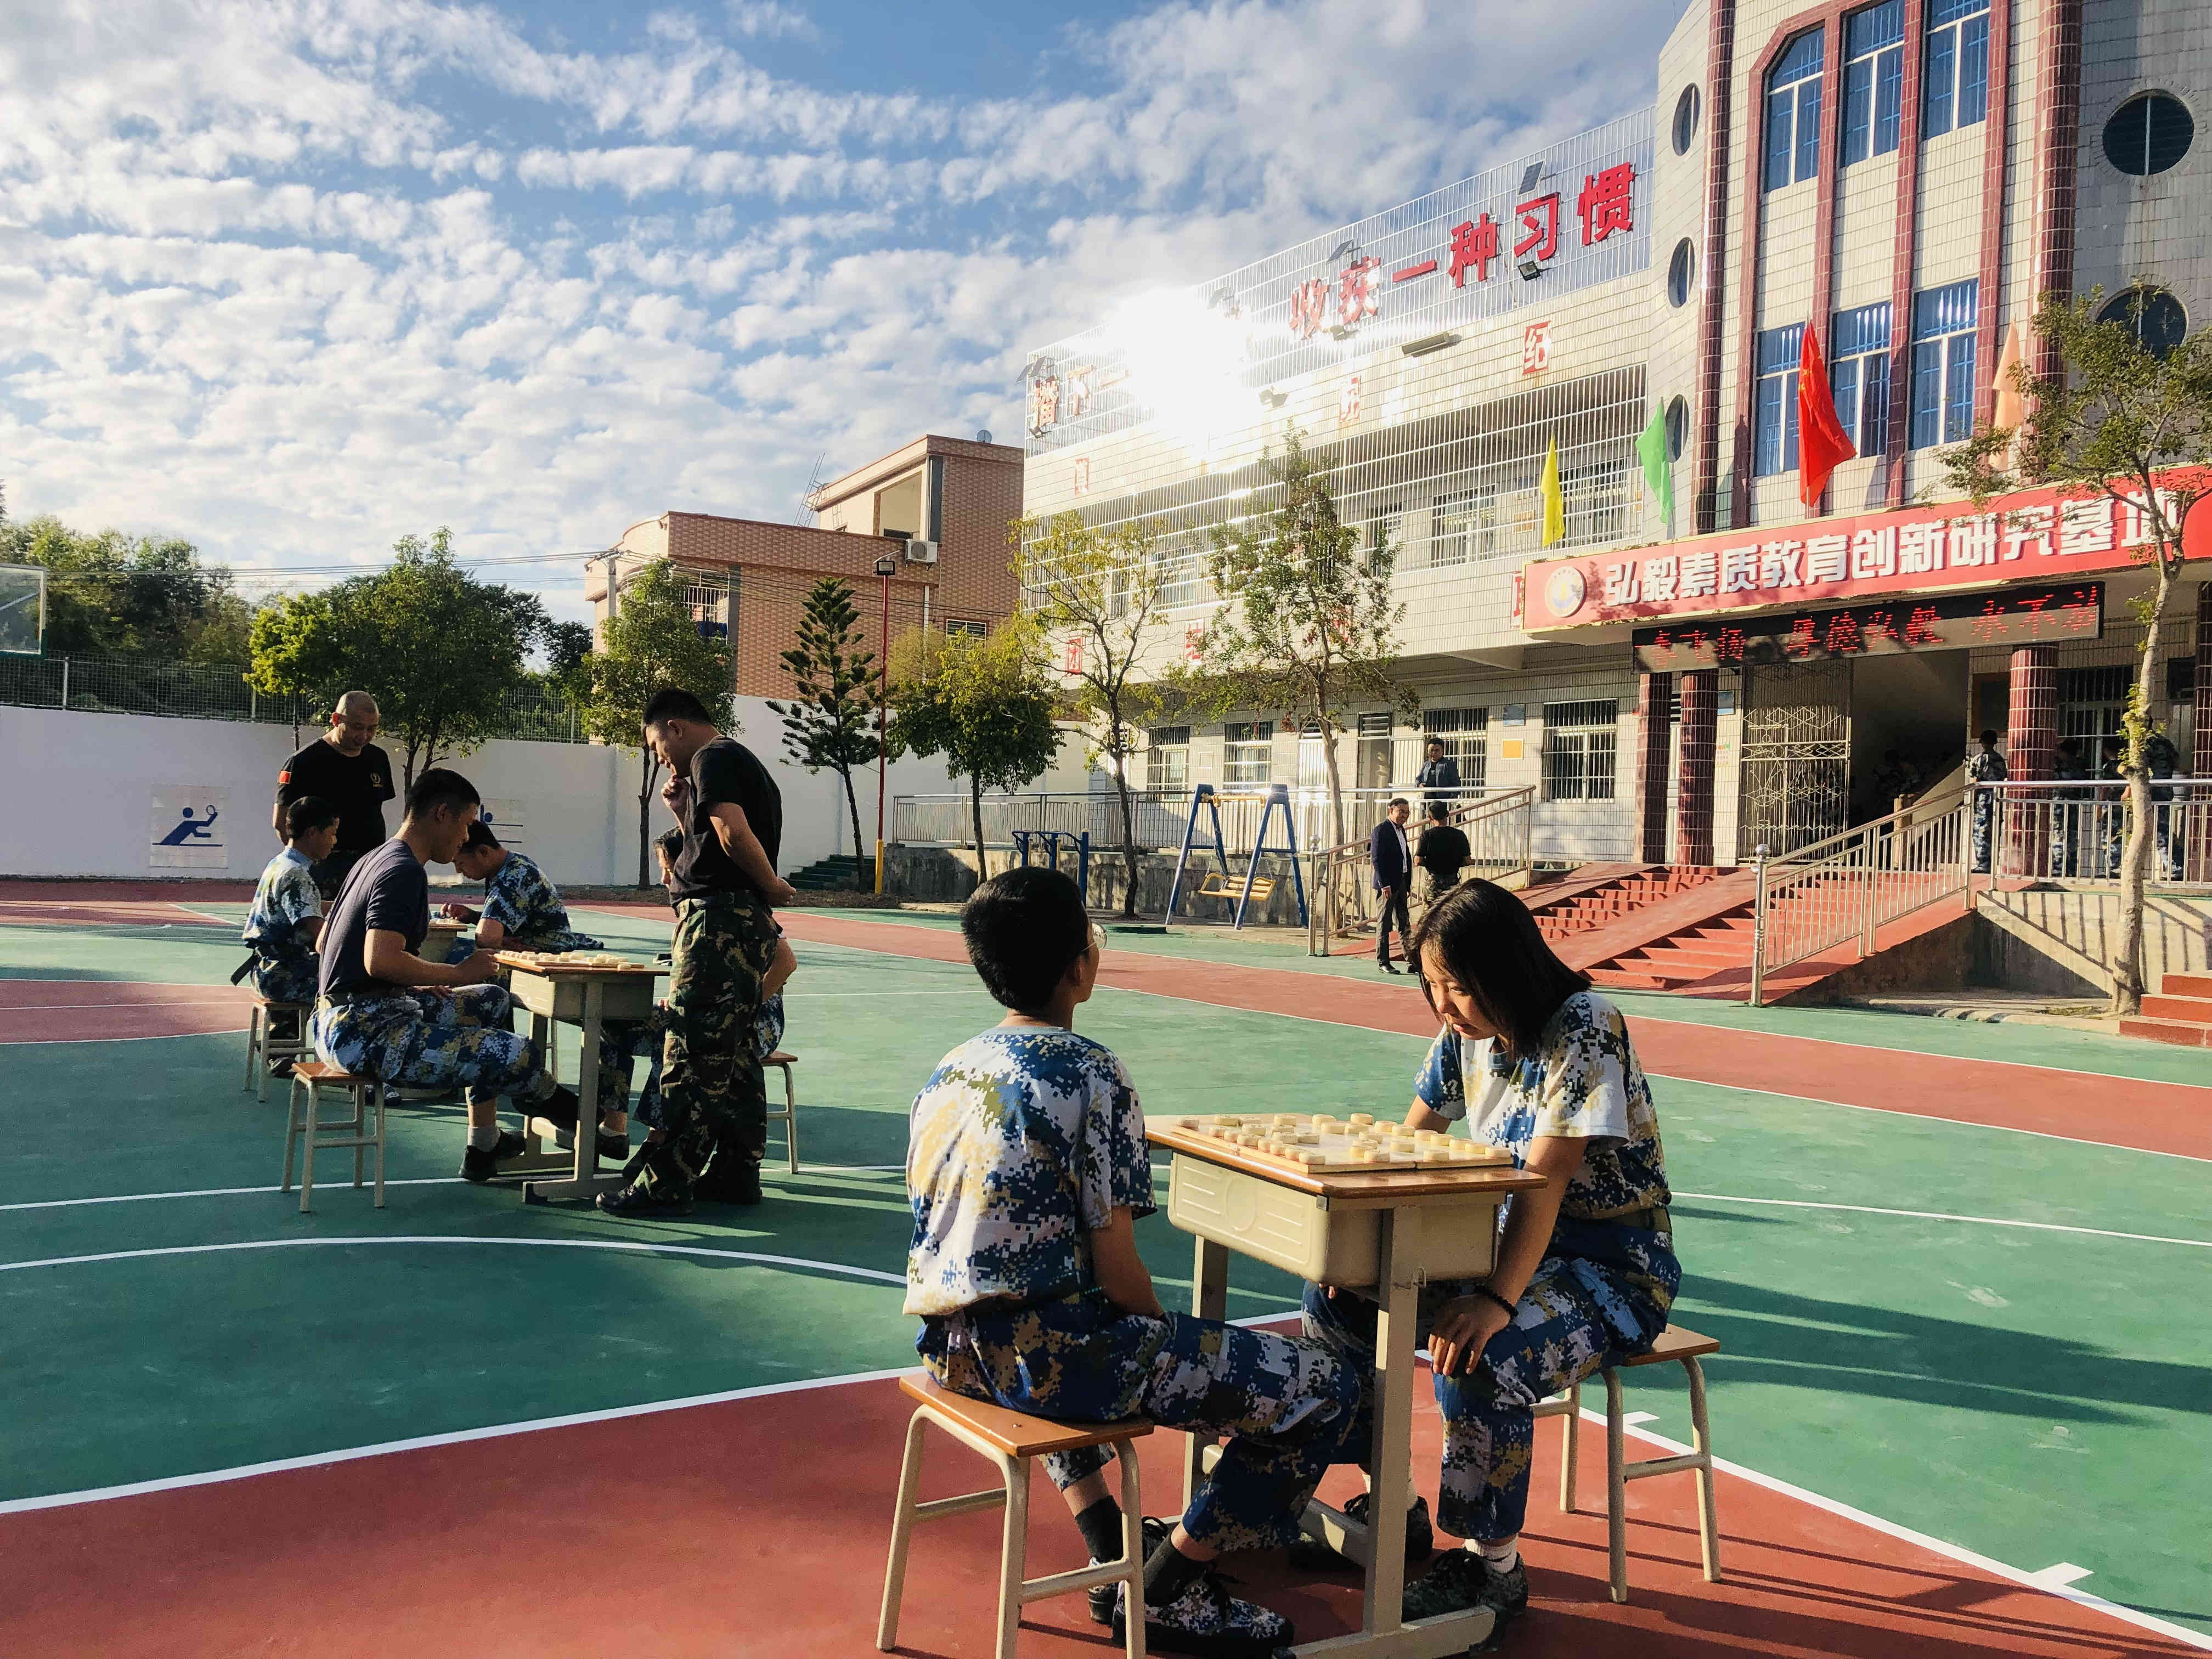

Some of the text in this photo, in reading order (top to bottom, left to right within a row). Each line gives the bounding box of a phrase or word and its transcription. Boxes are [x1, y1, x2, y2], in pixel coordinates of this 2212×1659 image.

[1289, 162, 1636, 340] 收获一种习惯
[1605, 486, 2181, 606] 弘毅素质教育创新研究基地
